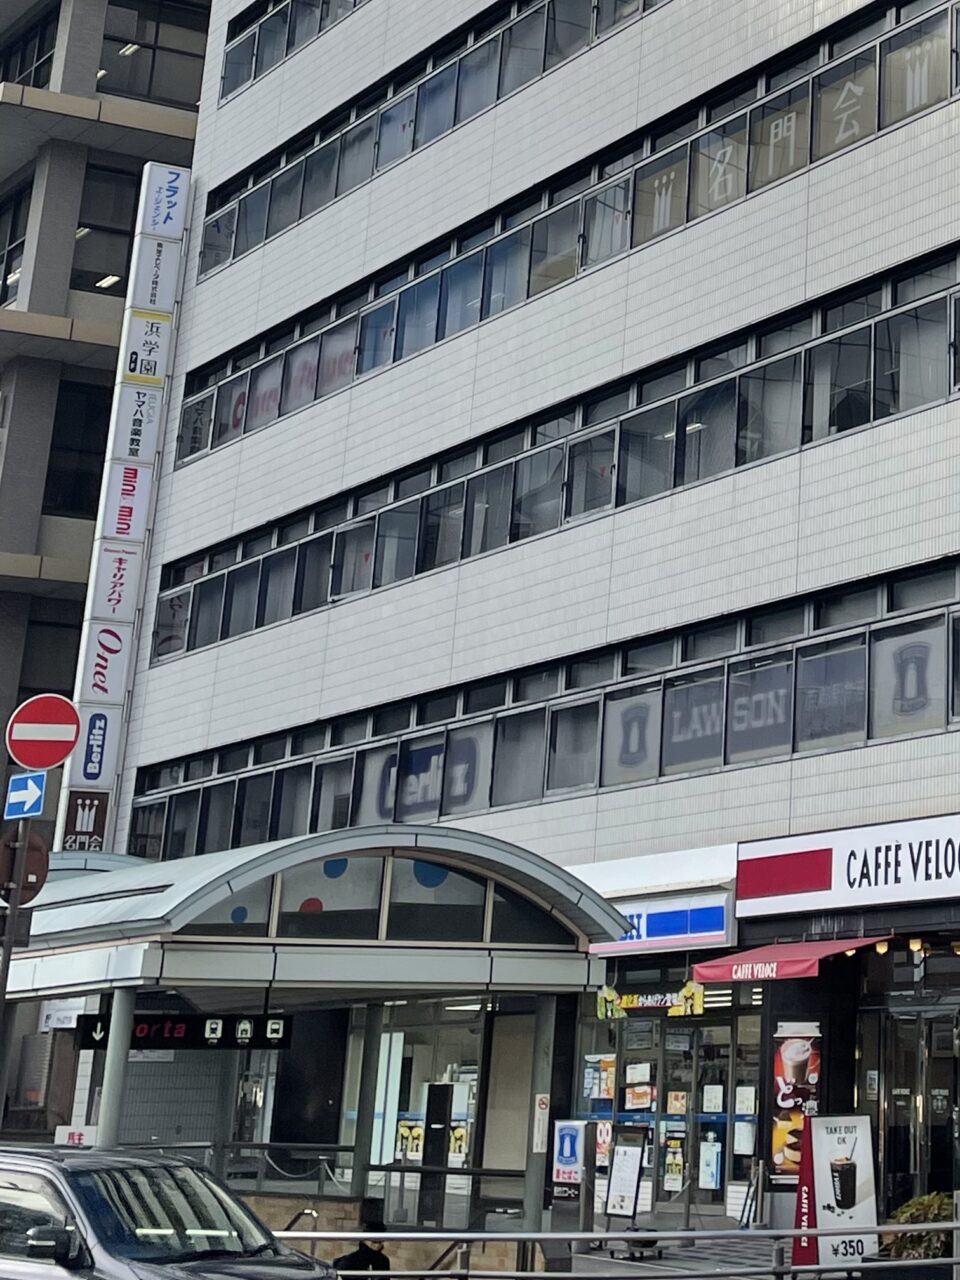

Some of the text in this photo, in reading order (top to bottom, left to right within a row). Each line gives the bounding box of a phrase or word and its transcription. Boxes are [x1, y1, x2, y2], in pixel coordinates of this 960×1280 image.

[709, 80, 865, 202] 名門会
[163, 171, 181, 225] フラット
[140, 321, 162, 376] 浜学園
[127, 391, 147, 458] ヤマハ音楽教室
[107, 557, 128, 614] キャリアパワー
[671, 689, 788, 743] LAWSON
[86, 719, 105, 774] Berlitz
[64, 834, 102, 851] 名門会
[753, 962, 778, 979] VELOCE
[134, 1021, 186, 1038] orta
[825, 1125, 858, 1136] TAKE OUT
[837, 1136, 847, 1145] OK
[800, 1213, 809, 1248] VELCE
[831, 1238, 865, 1258] ¥350
